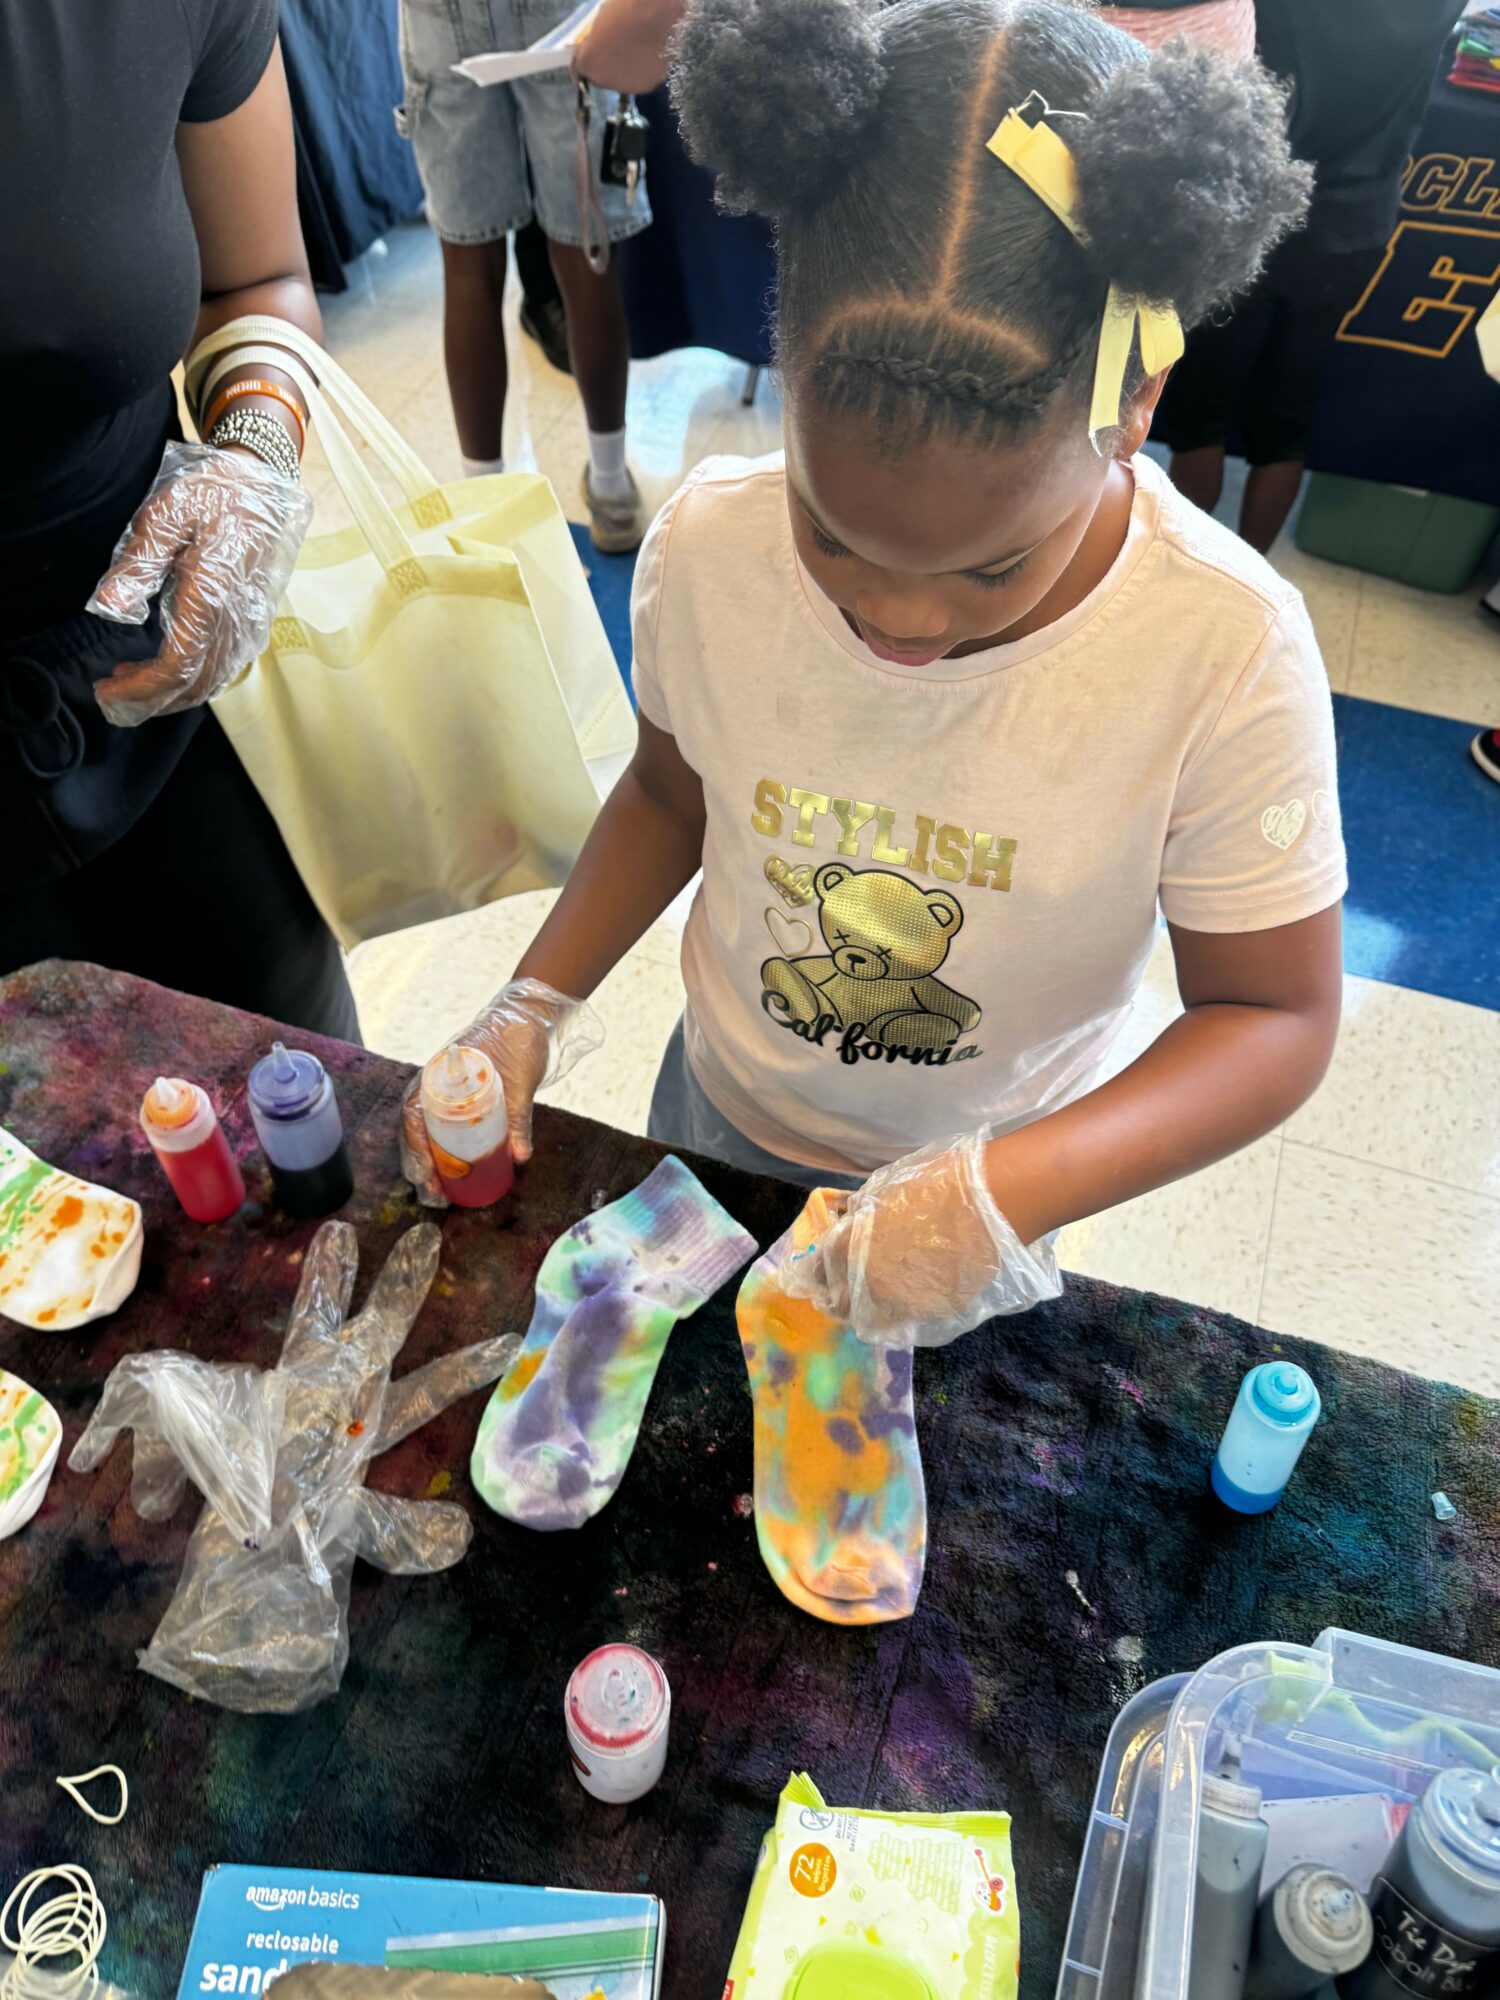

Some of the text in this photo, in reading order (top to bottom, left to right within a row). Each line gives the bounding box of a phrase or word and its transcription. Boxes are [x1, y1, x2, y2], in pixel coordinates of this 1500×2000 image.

[1400, 153, 1500, 219] CL
[751, 778, 1018, 892] STYLISH
[761, 989, 983, 1065] Calfornia
[794, 1853, 814, 1881] 72
[246, 1885, 360, 1911] amazon basics
[246, 1930, 339, 1954] reclosable
